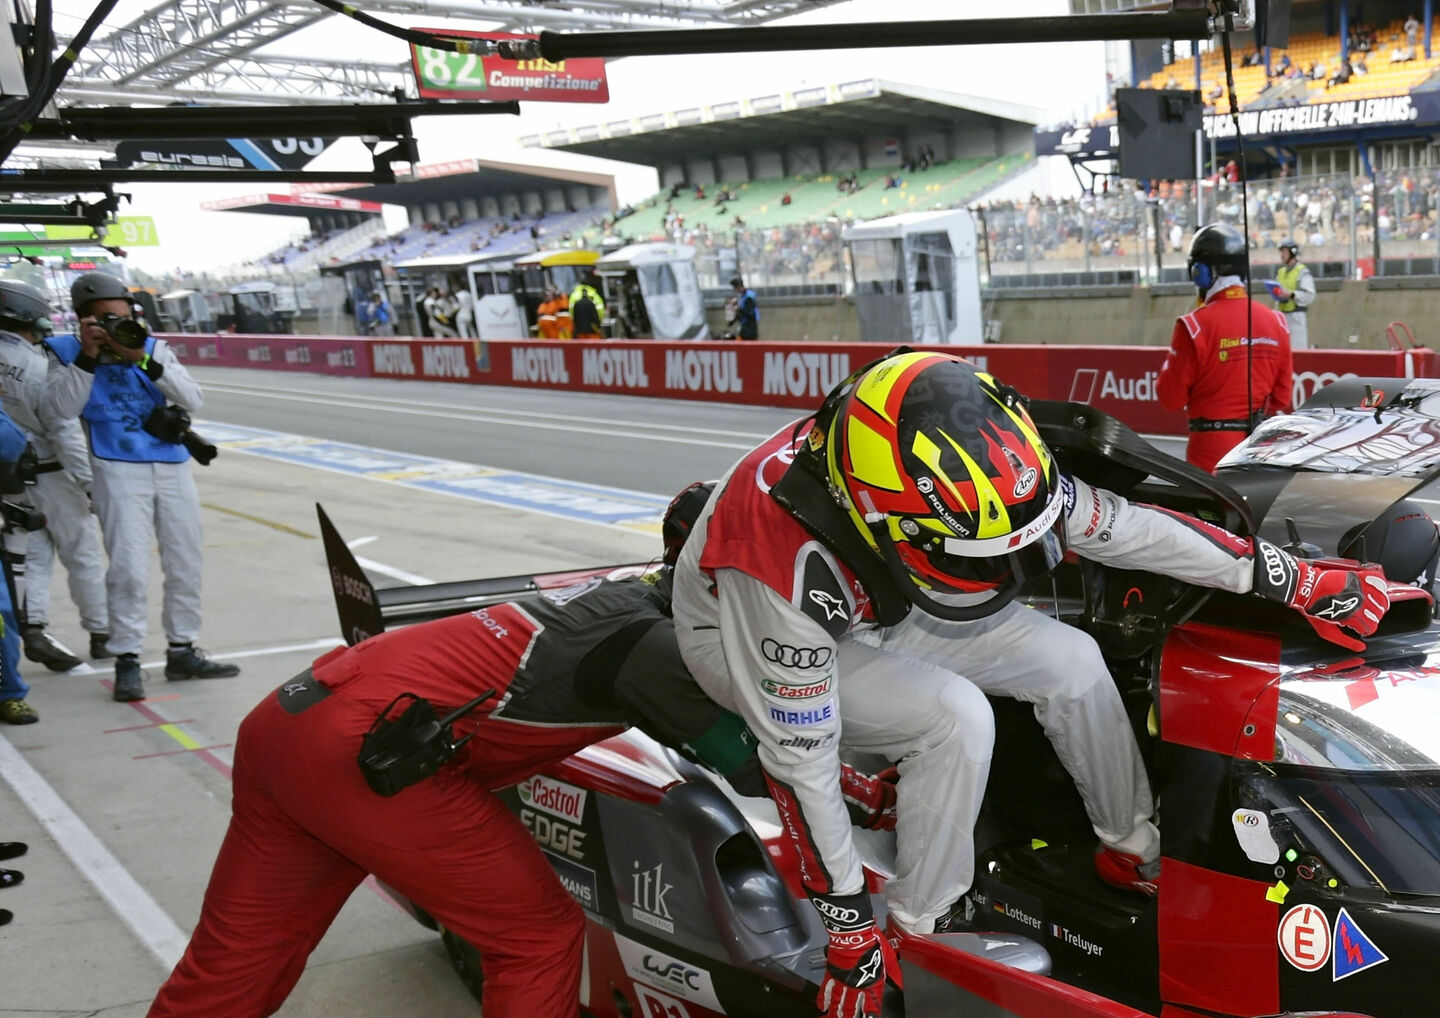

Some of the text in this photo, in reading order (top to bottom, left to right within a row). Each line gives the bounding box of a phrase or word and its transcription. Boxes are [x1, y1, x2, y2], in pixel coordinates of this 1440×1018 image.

[420, 42, 482, 86] 82
[489, 70, 602, 92] Competizione
[1259, 104, 1329, 133] OFFICIELLE
[141, 151, 244, 168] eurasia
[121, 220, 152, 242] 97
[373, 344, 415, 374] MOTUL
[422, 346, 470, 377] MOTUL
[512, 348, 570, 384] MOTUL
[583, 349, 648, 388] MOTUL
[666, 350, 742, 393] MOTUL
[763, 353, 849, 398] MOTU
[1015, 473, 1034, 495] Arai
[929, 494, 970, 537] POLYGON
[1025, 518, 1051, 538] Audi
[779, 681, 827, 697] Castrol
[770, 706, 831, 724] MAHLE
[532, 778, 581, 819] Castrol
[520, 809, 586, 860] EDGE
[560, 876, 592, 900] MANS
[632, 860, 674, 920] itk
[1005, 902, 1041, 930] Lotterer
[1063, 928, 1103, 957] Treluyer
[1295, 926, 1314, 960] E
[643, 955, 699, 990] WEC
